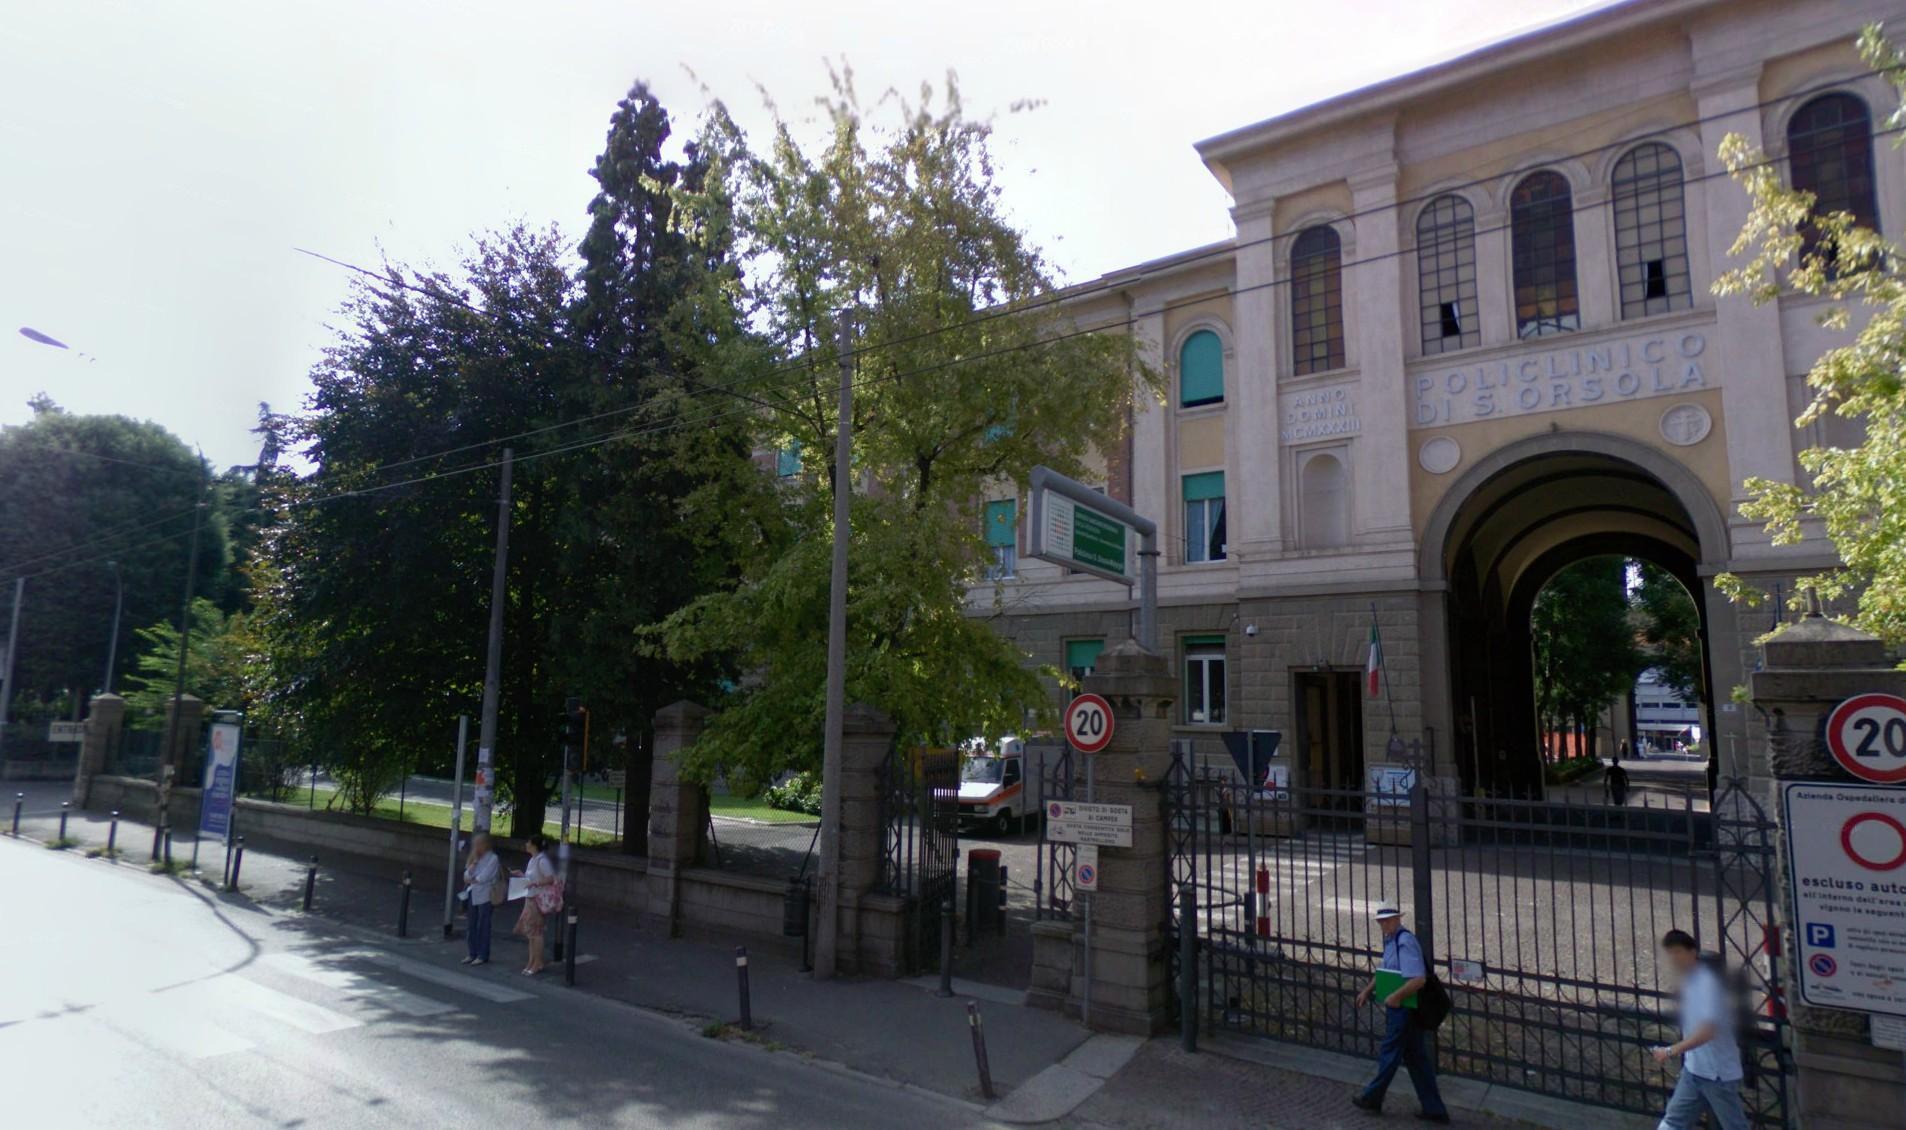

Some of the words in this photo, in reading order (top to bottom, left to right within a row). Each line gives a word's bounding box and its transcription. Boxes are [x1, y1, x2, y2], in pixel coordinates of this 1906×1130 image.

[1416, 335, 1706, 399] POLICLINICO
[1294, 389, 1346, 409] ANNO
[1416, 399, 1450, 424] DI
[1473, 393, 1503, 417] S.
[1518, 362, 1707, 410] ORSOLA
[1286, 402, 1354, 426] DOMINI
[1077, 709, 1103, 736] 20
[1853, 717, 1906, 757] 20
[1797, 791, 1833, 801] Azienda
[1802, 877, 1864, 891] escluso
[1803, 891, 1853, 902] all'interno
[1856, 896, 1901, 906] dell'area
[1812, 926, 1830, 944] P
